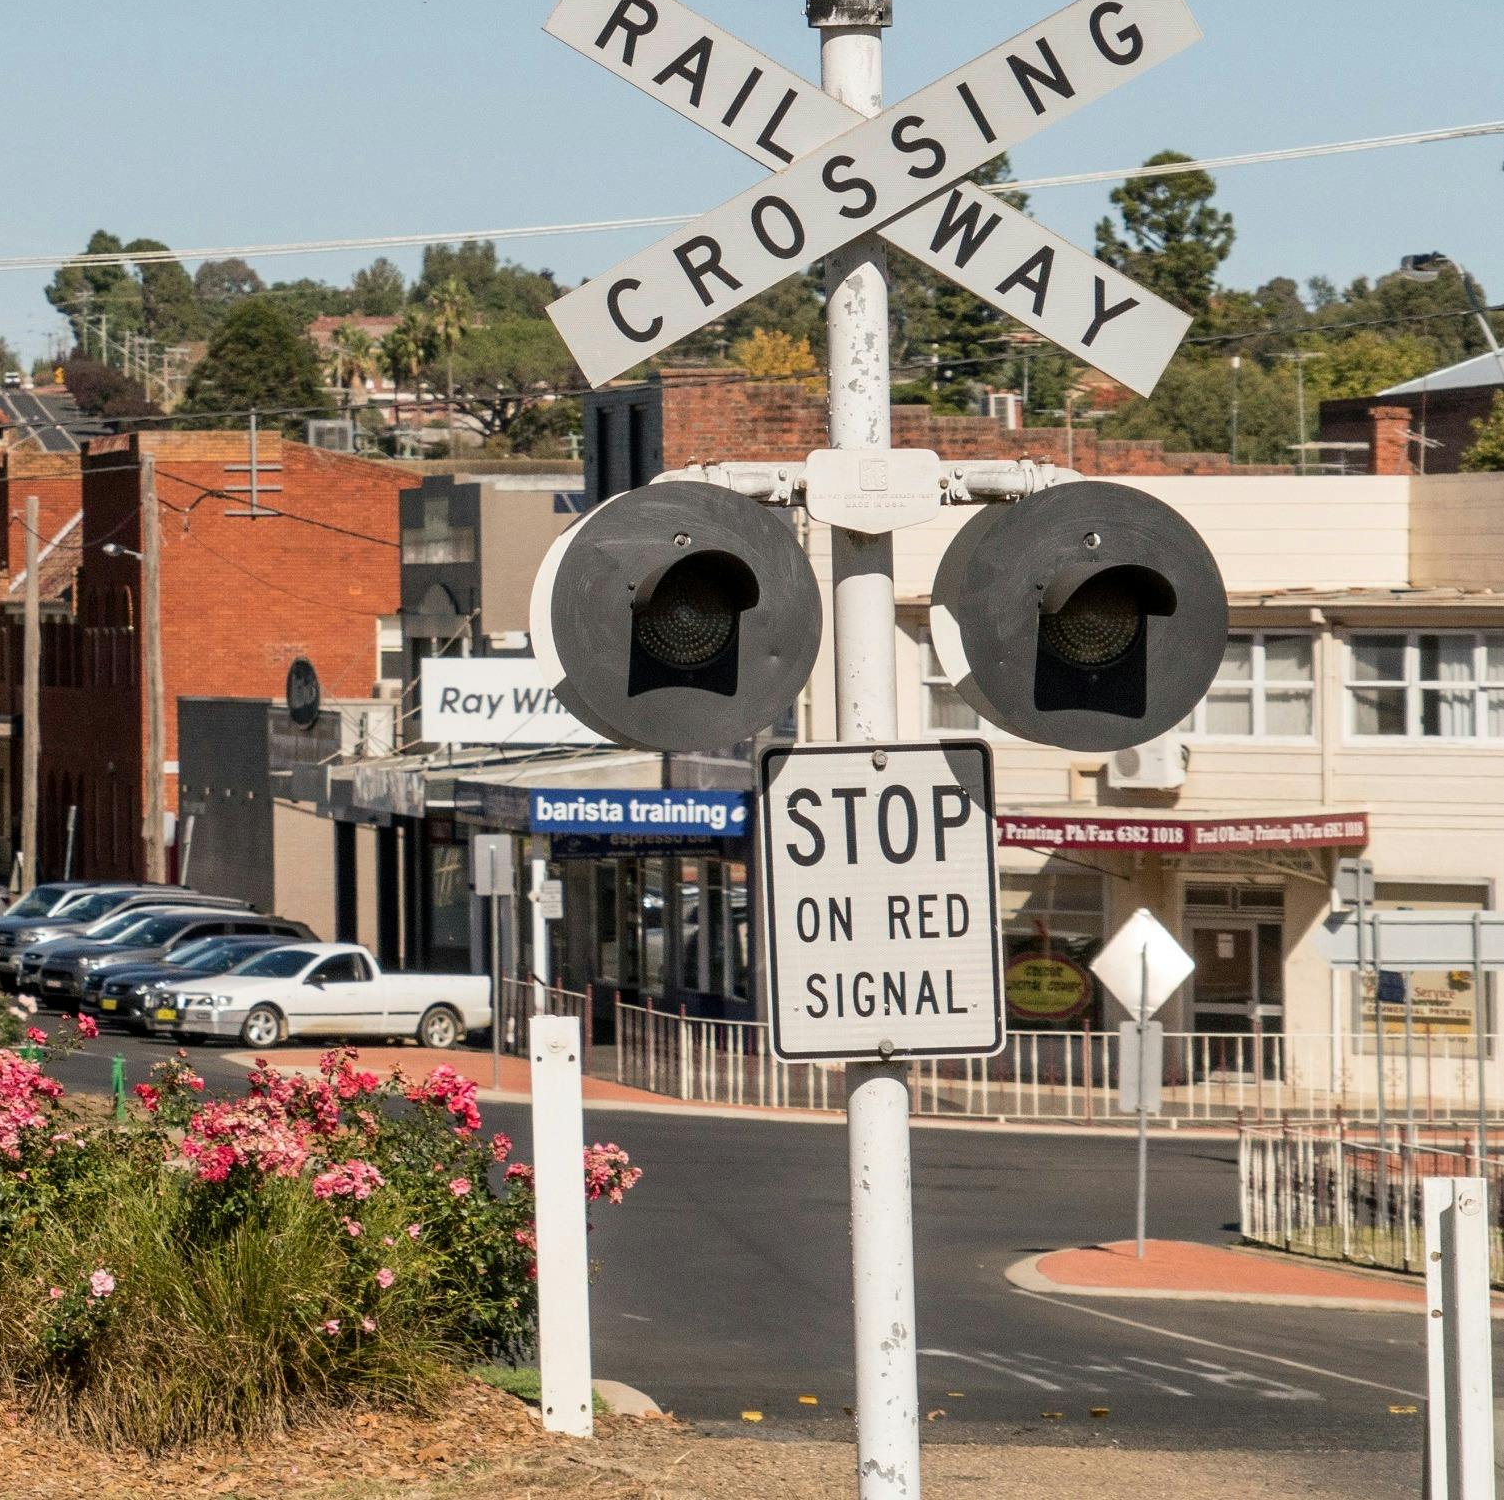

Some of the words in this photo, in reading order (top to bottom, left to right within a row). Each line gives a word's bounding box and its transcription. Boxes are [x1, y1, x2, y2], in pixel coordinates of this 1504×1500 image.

[607, 0, 1144, 344] CROSSING
[439, 687, 504, 719] Ray
[513, 687, 568, 714] Wh
[536, 797, 623, 822] barista
[630, 798, 727, 830] training
[786, 784, 971, 866] STOP
[1005, 823, 1063, 844] Printing
[1065, 824, 1114, 842] Ph/Fax
[1116, 826, 1149, 842] 6382
[1151, 827, 1184, 843] 1018
[1196, 827, 1218, 843] Fred
[1219, 825, 1254, 844] O'Reilly
[1255, 824, 1291, 843] Printing
[1292, 823, 1323, 839] Ph/Fax
[1324, 822, 1343, 838] 6382
[1345, 821, 1364, 836] 1018
[796, 896, 853, 943] ON
[887, 893, 970, 940] RED
[805, 970, 968, 1019] SIGNAL
[1414, 987, 1456, 999] Service
[1429, 1007, 1472, 1017] PRINTERS
